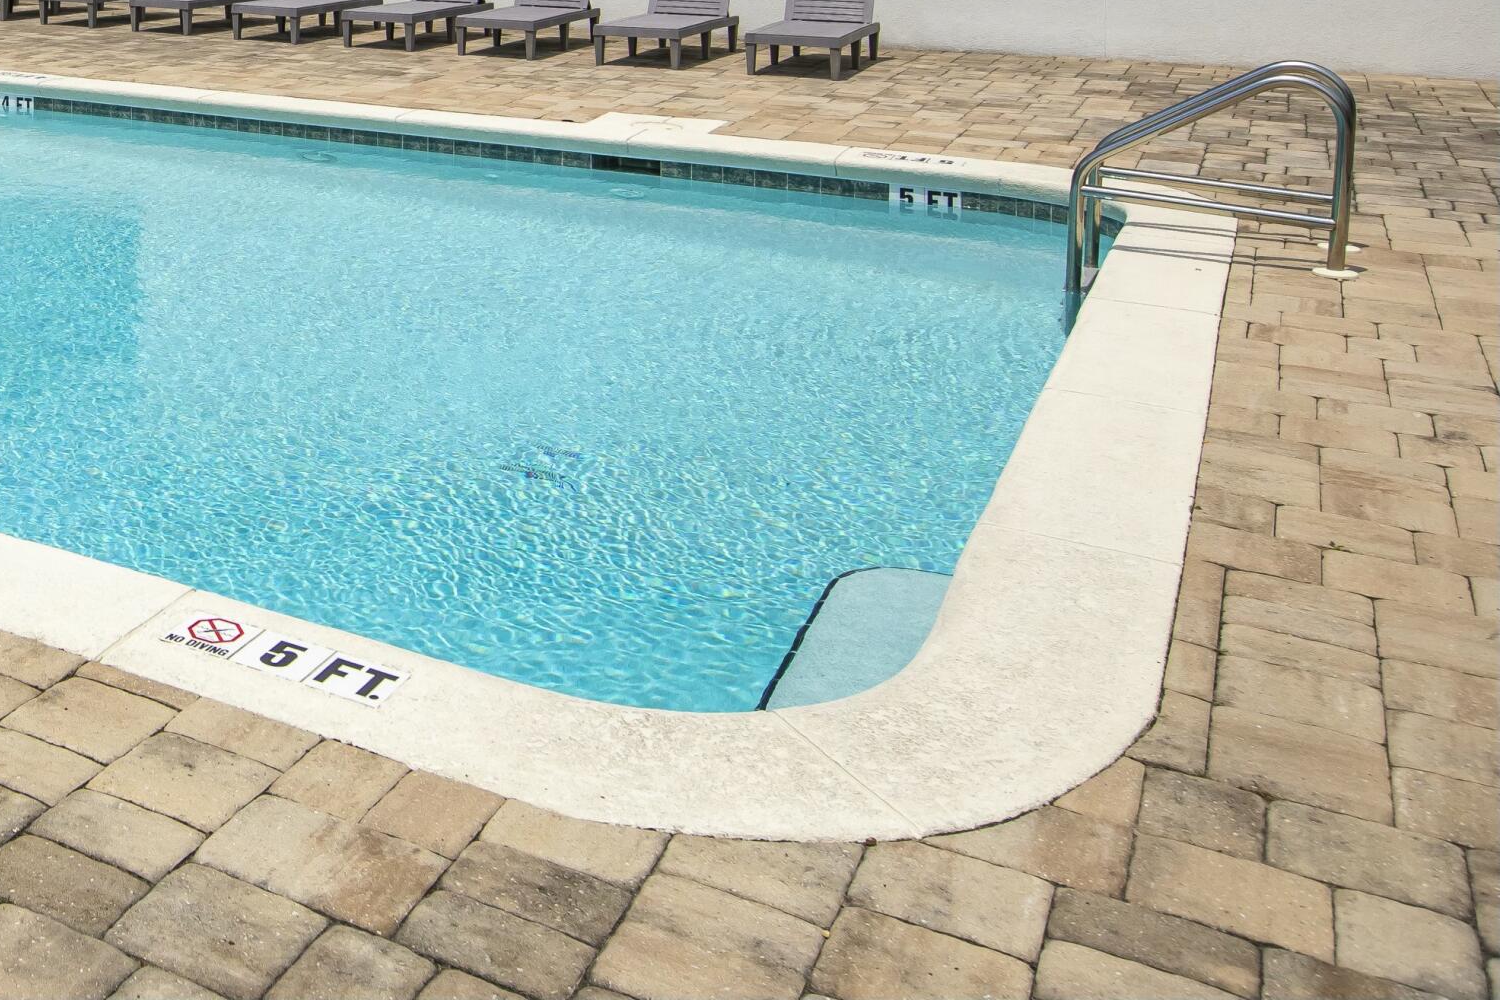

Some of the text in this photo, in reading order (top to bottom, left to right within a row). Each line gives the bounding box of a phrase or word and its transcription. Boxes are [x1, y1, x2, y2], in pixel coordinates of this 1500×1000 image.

[16, 96, 33, 109] FT
[899, 187, 958, 208] 5 FT
[164, 633, 230, 657] NO DIVING
[259, 640, 400, 700] 5 FT.
